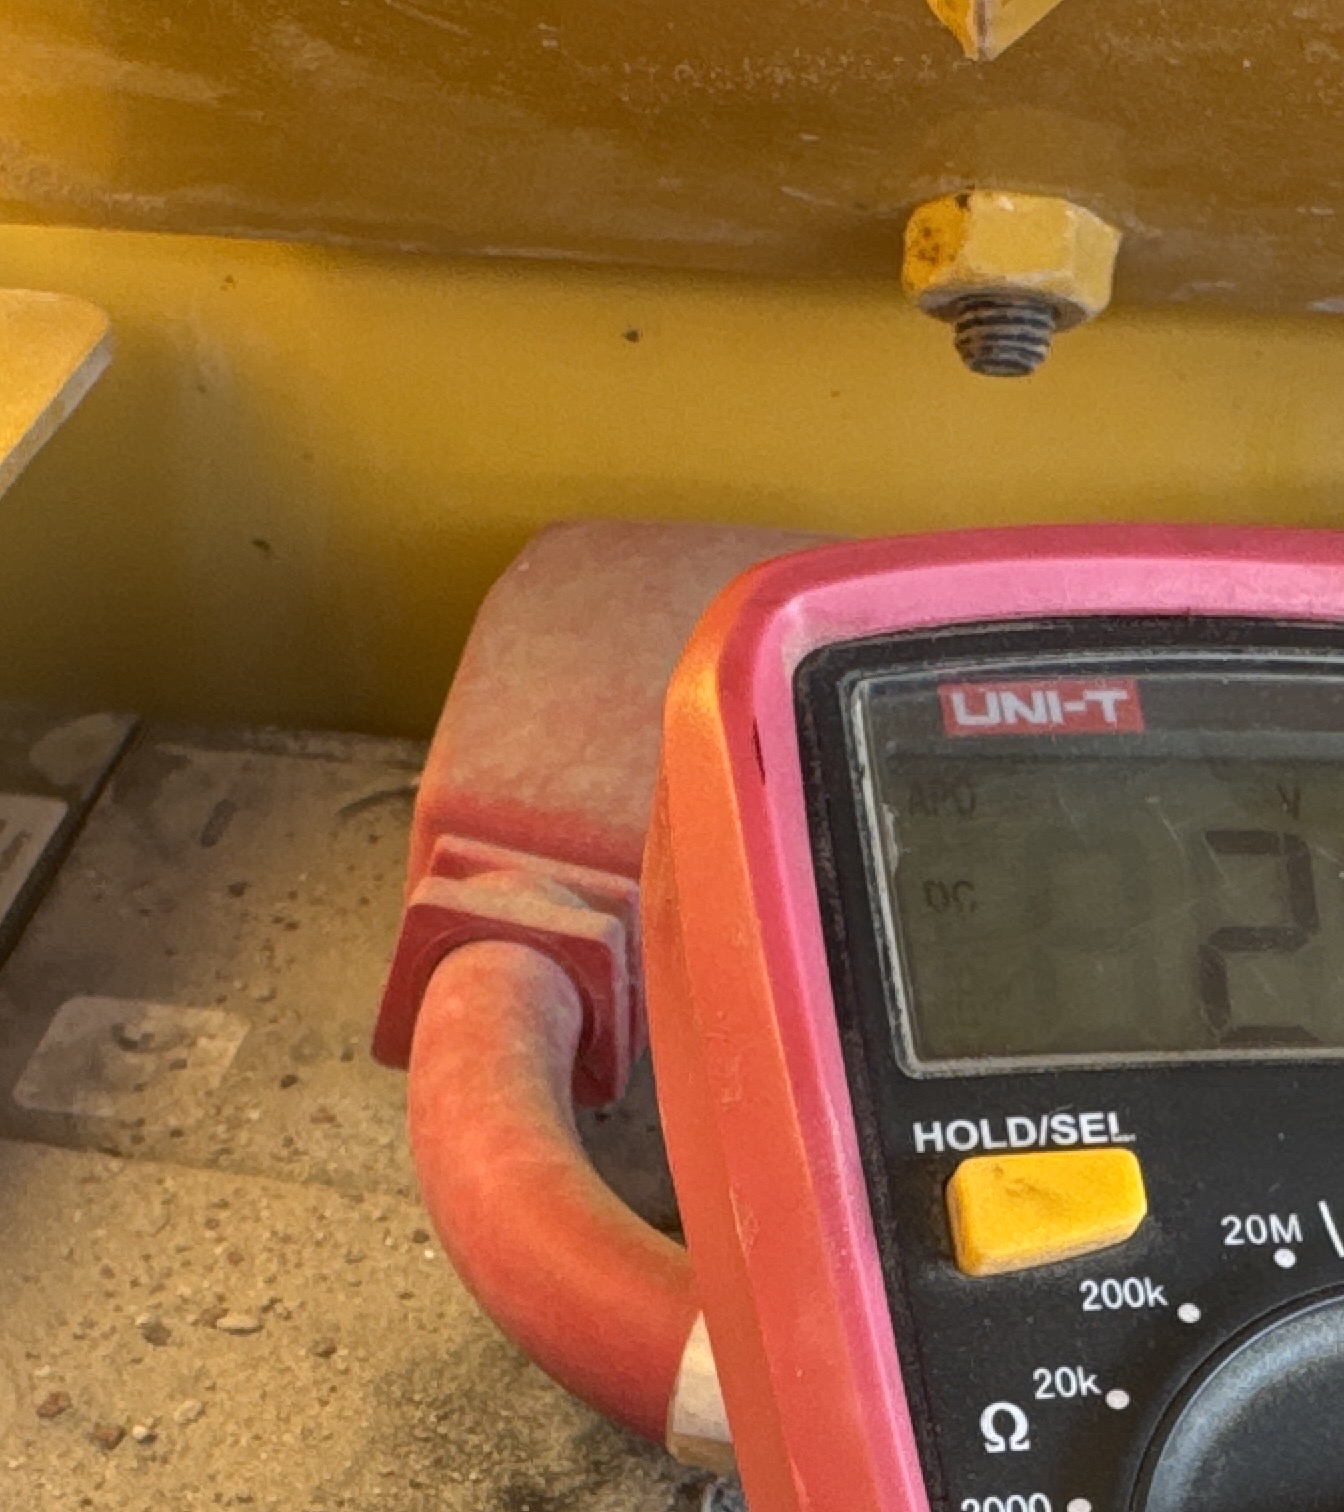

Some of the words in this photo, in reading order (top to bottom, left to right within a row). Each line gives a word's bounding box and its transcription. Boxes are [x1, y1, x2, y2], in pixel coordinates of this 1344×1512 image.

[951, 686, 1130, 727] UNI-T
[912, 1112, 1136, 1154] HOLD/SEL
[1220, 1213, 1304, 1246] 20M
[1080, 1276, 1168, 1312] 200k
[1032, 1366, 1102, 1400] 20k
